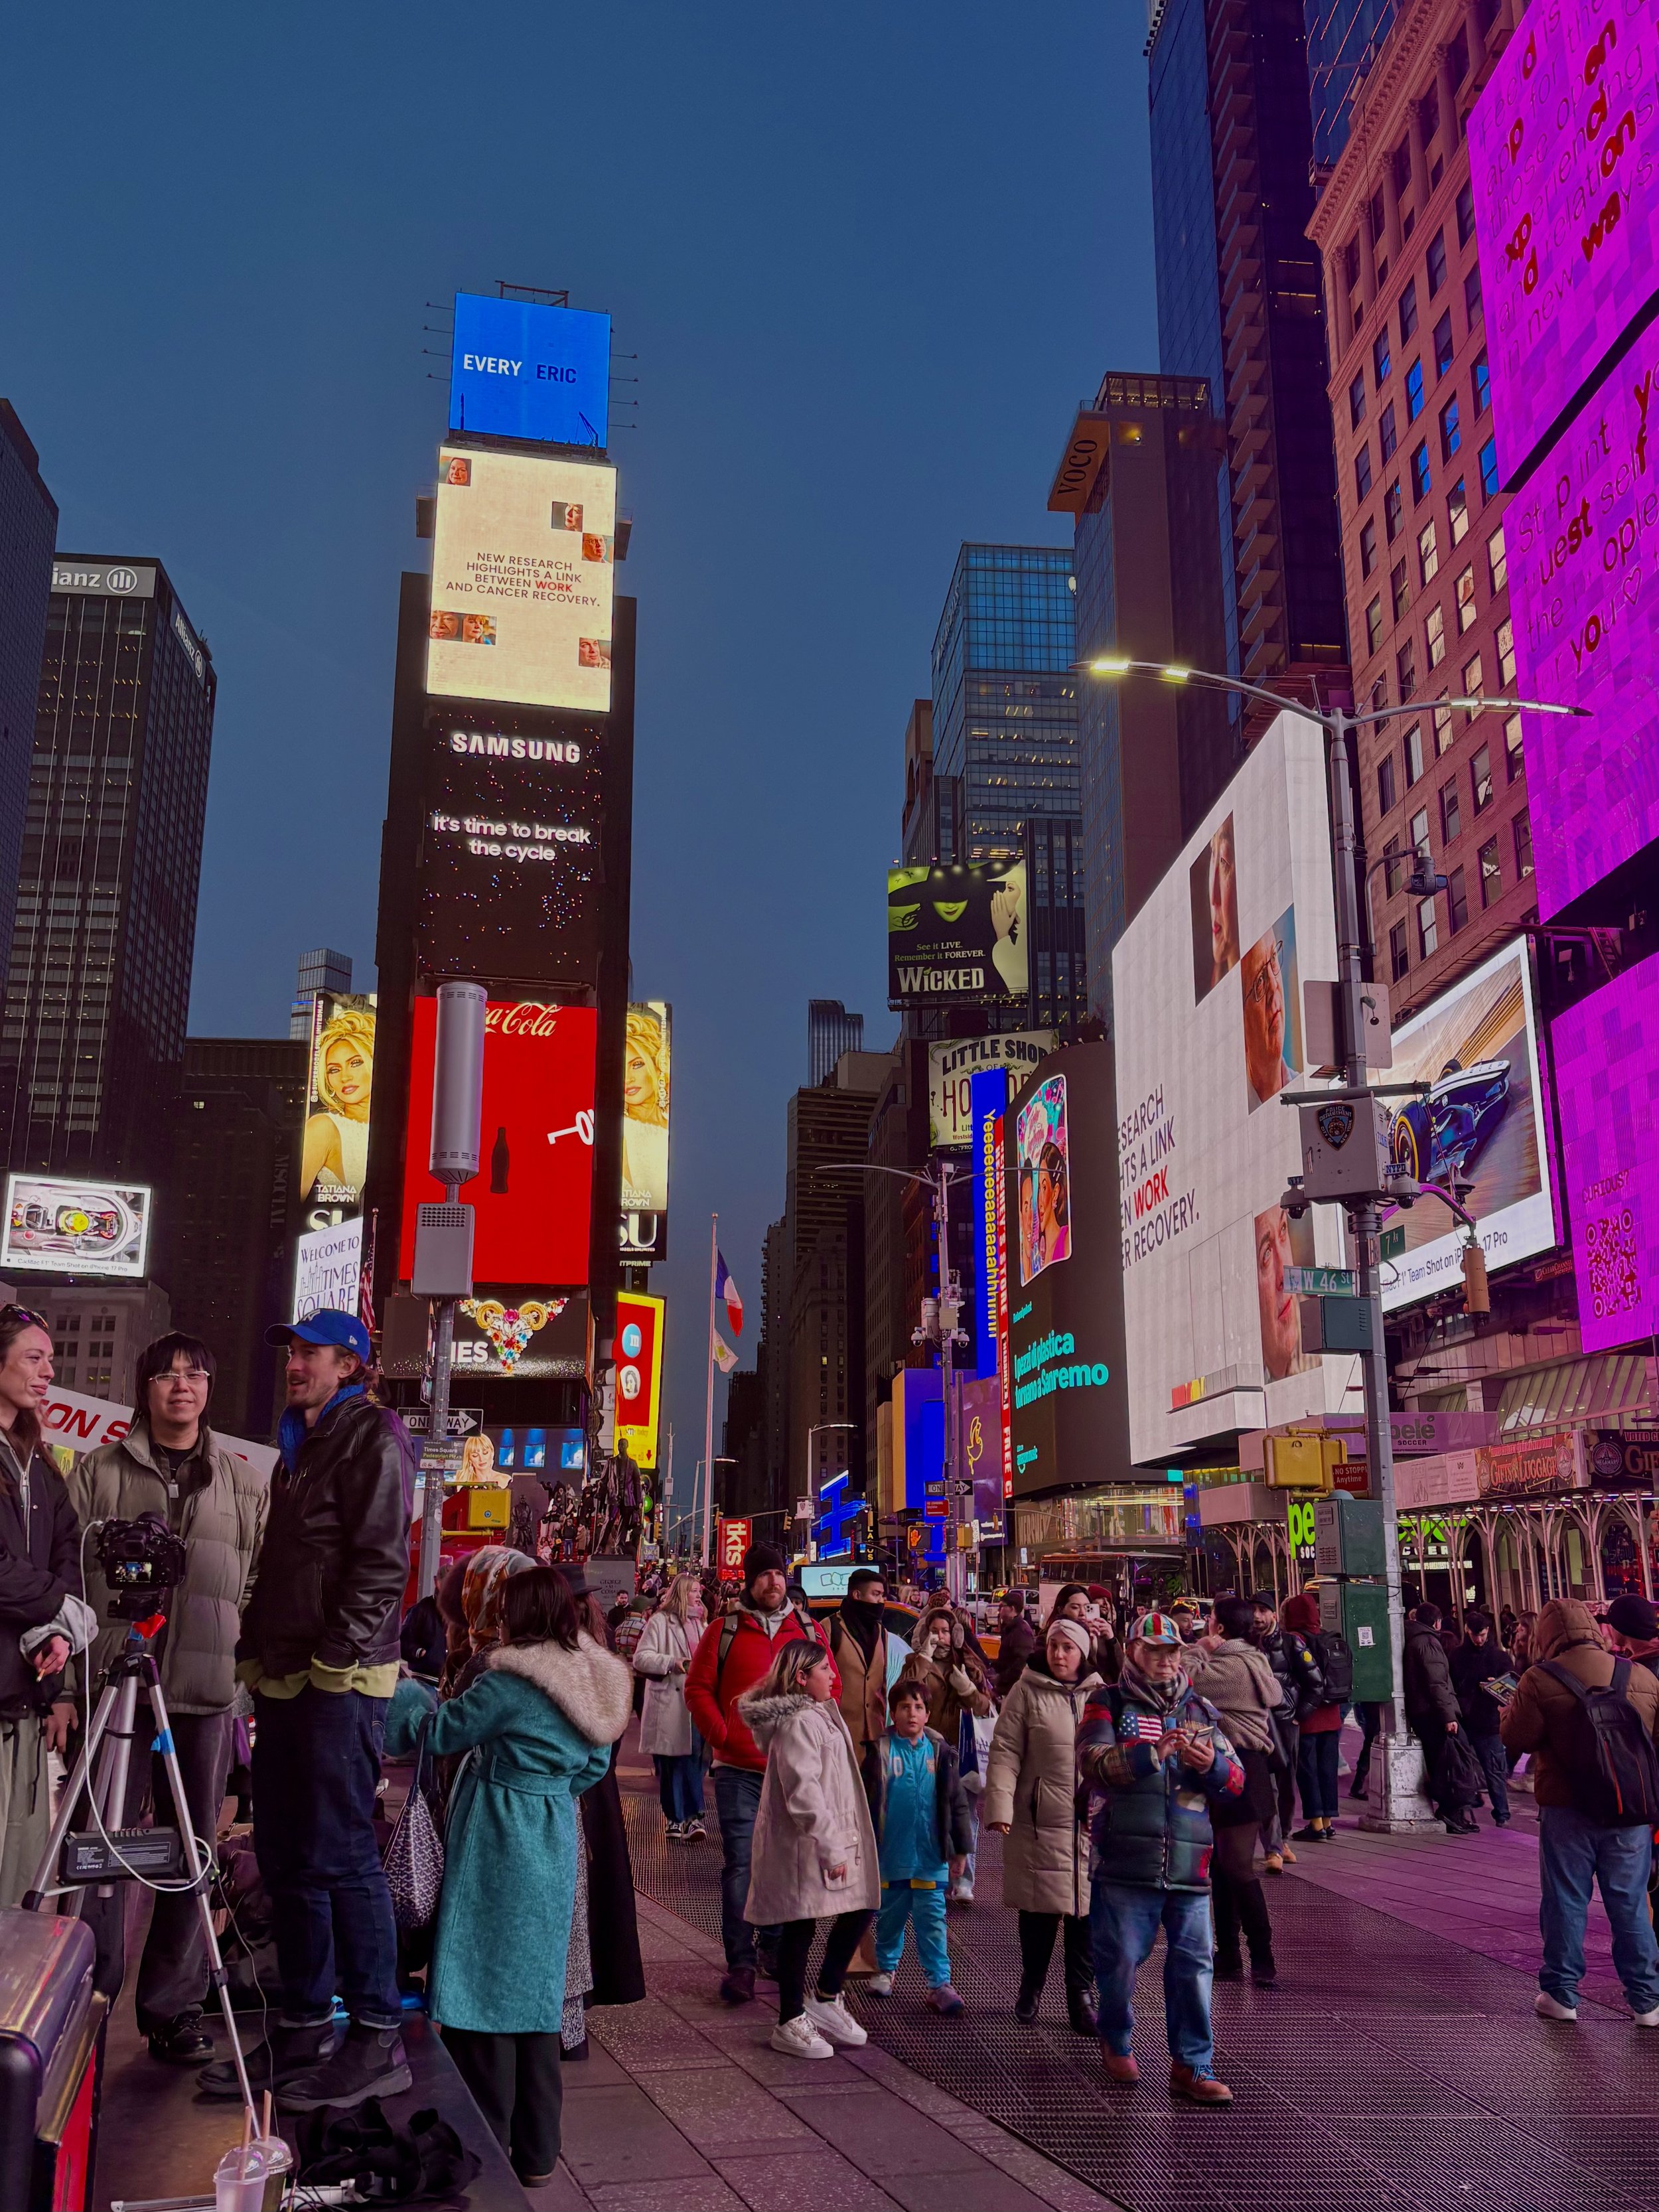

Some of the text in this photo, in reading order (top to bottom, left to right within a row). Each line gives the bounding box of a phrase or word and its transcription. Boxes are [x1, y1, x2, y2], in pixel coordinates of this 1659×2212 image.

[1486, 117, 1524, 196] app
[1530, 53, 1559, 119] for
[1494, 44, 1643, 285] experiencing
[1490, 132, 1549, 239] those
[1499, 245, 1538, 332] and
[1528, 256, 1573, 345] new
[463, 354, 577, 384] EVERY ERIC
[1057, 439, 1098, 494] VOCO
[467, 561, 581, 583] HIGHLIGHTS A LINK
[477, 552, 572, 571] NEW RESEARCH
[51, 567, 101, 587] ianz
[475, 573, 573, 593] BETWEEN WORK
[446, 581, 601, 607] AND CANCER RECOVERY.
[175, 612, 196, 662] Allianz
[452, 733, 581, 764] SAMSUNG
[464, 818, 507, 836] time
[511, 822, 532, 839] to
[535, 825, 591, 845] break
[469, 840, 556, 863] the cycle
[895, 952, 935, 962] Remember
[945, 950, 986, 959] FOREVER.
[940, 941, 963, 950] LIVE.
[485, 1002, 563, 1037] a-Cola
[942, 1039, 1049, 1076] LITTLE SHOP
[1118, 1083, 1165, 1153] SEARCH
[1140, 1143, 1148, 1176] A
[1150, 1115, 1176, 1167] LINK
[1386, 1163, 1406, 1174] NYPD
[317, 1184, 356, 1194] TATIANA
[317, 1193, 354, 1203] BROWN
[622, 1189, 652, 1198] TIANA
[1133, 1164, 1169, 1220] WORK
[1581, 1168, 1630, 1205] CURIOUS?
[621, 1198, 650, 1207] ROWN
[1134, 1188, 1199, 1262] RECOVERY.
[301, 1236, 360, 1264] WELCOME TO
[1386, 1234, 1391, 1255] 7
[1407, 1267, 1426, 1283] Team
[1426, 1260, 1443, 1276] Shot
[1444, 1255, 1454, 1268] on
[1482, 1234, 1492, 1252] 17
[1493, 1231, 1508, 1248] Pro
[323, 1262, 358, 1291] TIMES
[1303, 1270, 1350, 1292] W 46 St
[1017, 1345, 1031, 1382] pezzi
[1037, 1329, 1075, 1371] plastica
[1041, 1363, 1109, 1396] Sanremo
[41, 1398, 101, 1439] ON
[1335, 1466, 1367, 1475] NO STOPPI
[1336, 1475, 1362, 1485] Anytime
[726, 1522, 747, 1566] tkts
